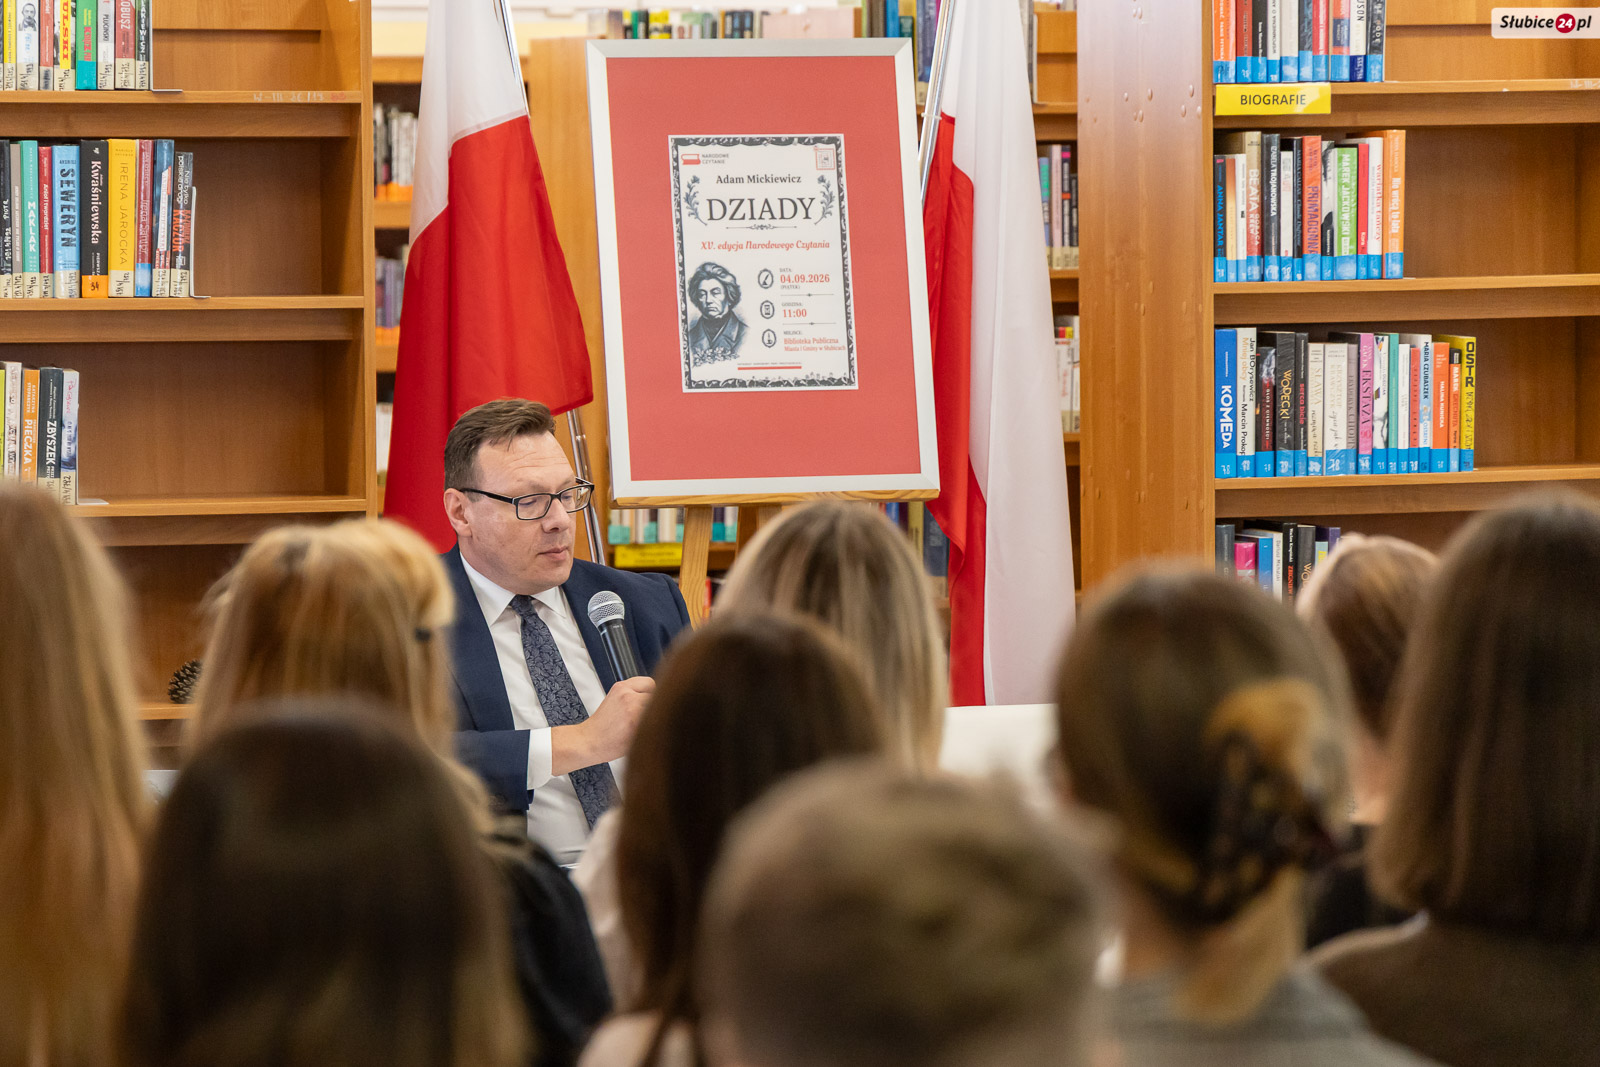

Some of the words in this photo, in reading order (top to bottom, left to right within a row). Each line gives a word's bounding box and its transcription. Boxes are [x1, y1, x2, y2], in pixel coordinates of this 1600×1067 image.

[120, 0, 130, 30] OBUSZ
[1240, 94, 1306, 105] BIOGRAFIE
[120, 162, 128, 200] IRENA
[716, 175, 744, 184] Adam
[746, 174, 802, 183] Mickiewicz
[1342, 154, 1350, 183] MAREK
[60, 168, 77, 248] SEWERYN
[91, 160, 102, 244] Kwaśniewska
[706, 198, 815, 220] DZIADY
[1248, 169, 1260, 211] BEATA
[1342, 185, 1350, 235] JACKOWSKI
[28, 201, 36, 252] MAKLAK
[119, 205, 128, 265] JAROCKA
[172, 209, 184, 252] KACZOR
[701, 241, 716, 249] XV.
[718, 241, 744, 251] edycja
[746, 240, 794, 251] Narodowego
[796, 240, 830, 250] Czytania
[780, 274, 830, 283] 04.09.2026
[783, 309, 807, 318] 11:00
[1241, 337, 1249, 360] Mniej
[1465, 341, 1475, 387] OSTR
[1240, 361, 1249, 380] obcy
[1280, 370, 1292, 419] WODECKI
[1362, 370, 1371, 424] EKSTAZA
[1220, 385, 1233, 448] KOMEDA
[24, 419, 32, 464] PIECZKA
[46, 420, 57, 465] ZBYSZEK
